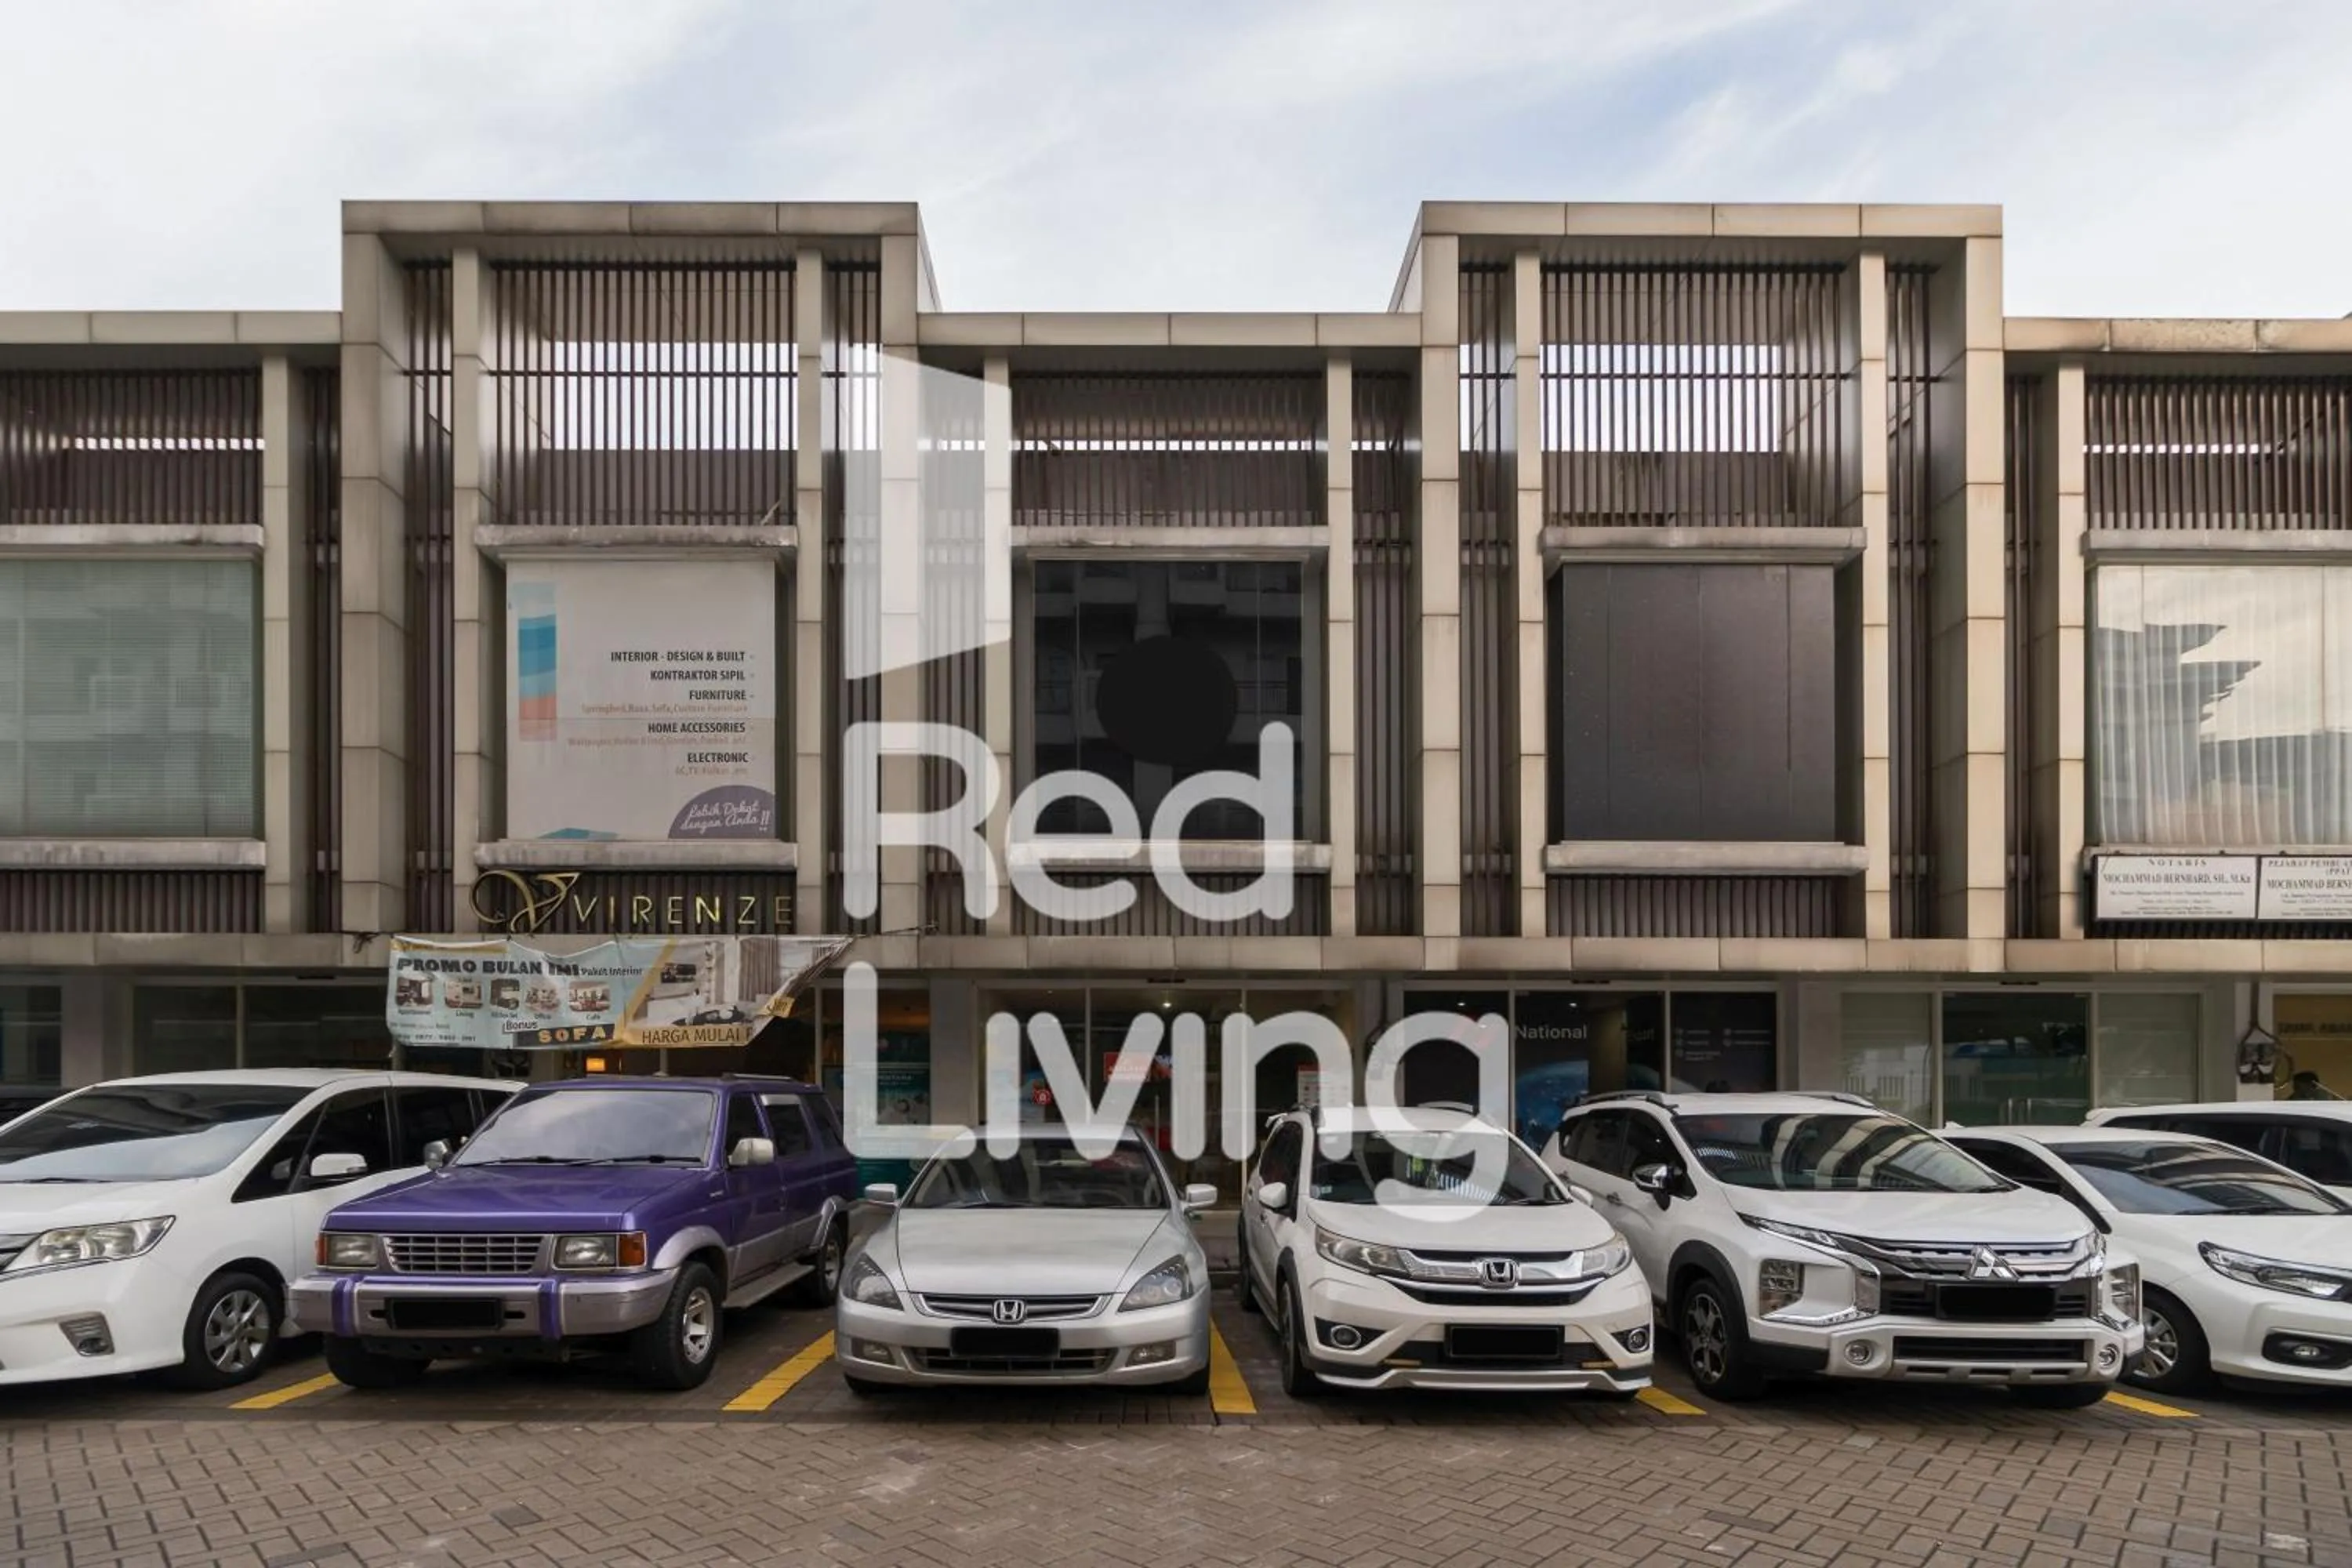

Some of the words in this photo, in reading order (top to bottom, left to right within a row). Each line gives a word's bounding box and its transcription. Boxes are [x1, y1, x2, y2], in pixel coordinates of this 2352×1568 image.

[611, 652, 659, 662] INTERIOR
[666, 652, 704, 662] DESIGN
[706, 652, 714, 662] &
[716, 652, 746, 662] BUILT
[650, 670, 718, 681] KONTRAKTOR
[720, 670, 746, 681] SIPIL
[689, 690, 747, 700] FURNITURE
[648, 723, 678, 733] HOME
[680, 723, 746, 733] ACCESSORIES
[688, 753, 749, 763] ELECTRONIC
[2103, 873, 2161, 884] MOCHAMMAD
[2267, 880, 2324, 889] MOCHAMMAD
[574, 895, 792, 924] VIRENZE
[397, 958, 477, 973] PROMO
[482, 960, 543, 975] BULAN
[538, 1025, 607, 1044] SOFA
[641, 1029, 691, 1044] HARGA
[695, 1028, 740, 1042] MULAI
[1515, 1025, 1588, 1040] National
